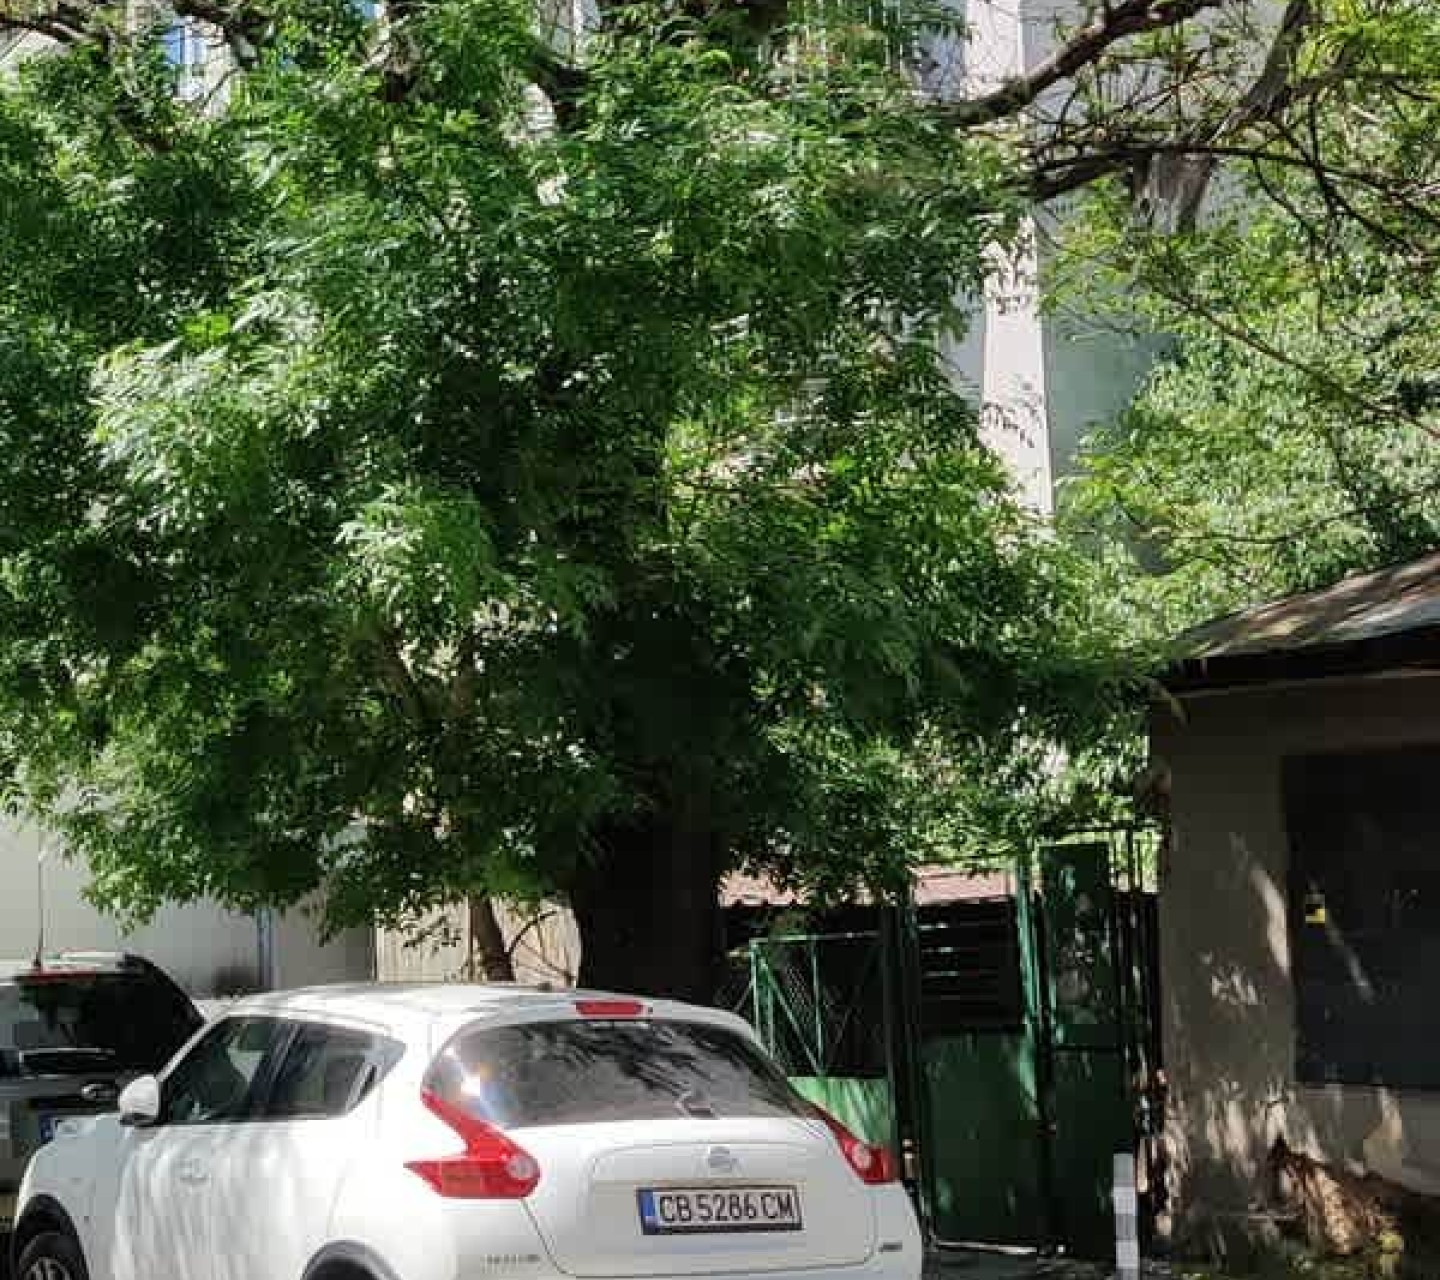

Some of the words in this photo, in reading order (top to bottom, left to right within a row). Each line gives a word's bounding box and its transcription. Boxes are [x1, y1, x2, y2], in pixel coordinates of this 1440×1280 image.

[659, 1195, 692, 1222] CB
[696, 1193, 757, 1221] 5286
[760, 1192, 793, 1219] CM
